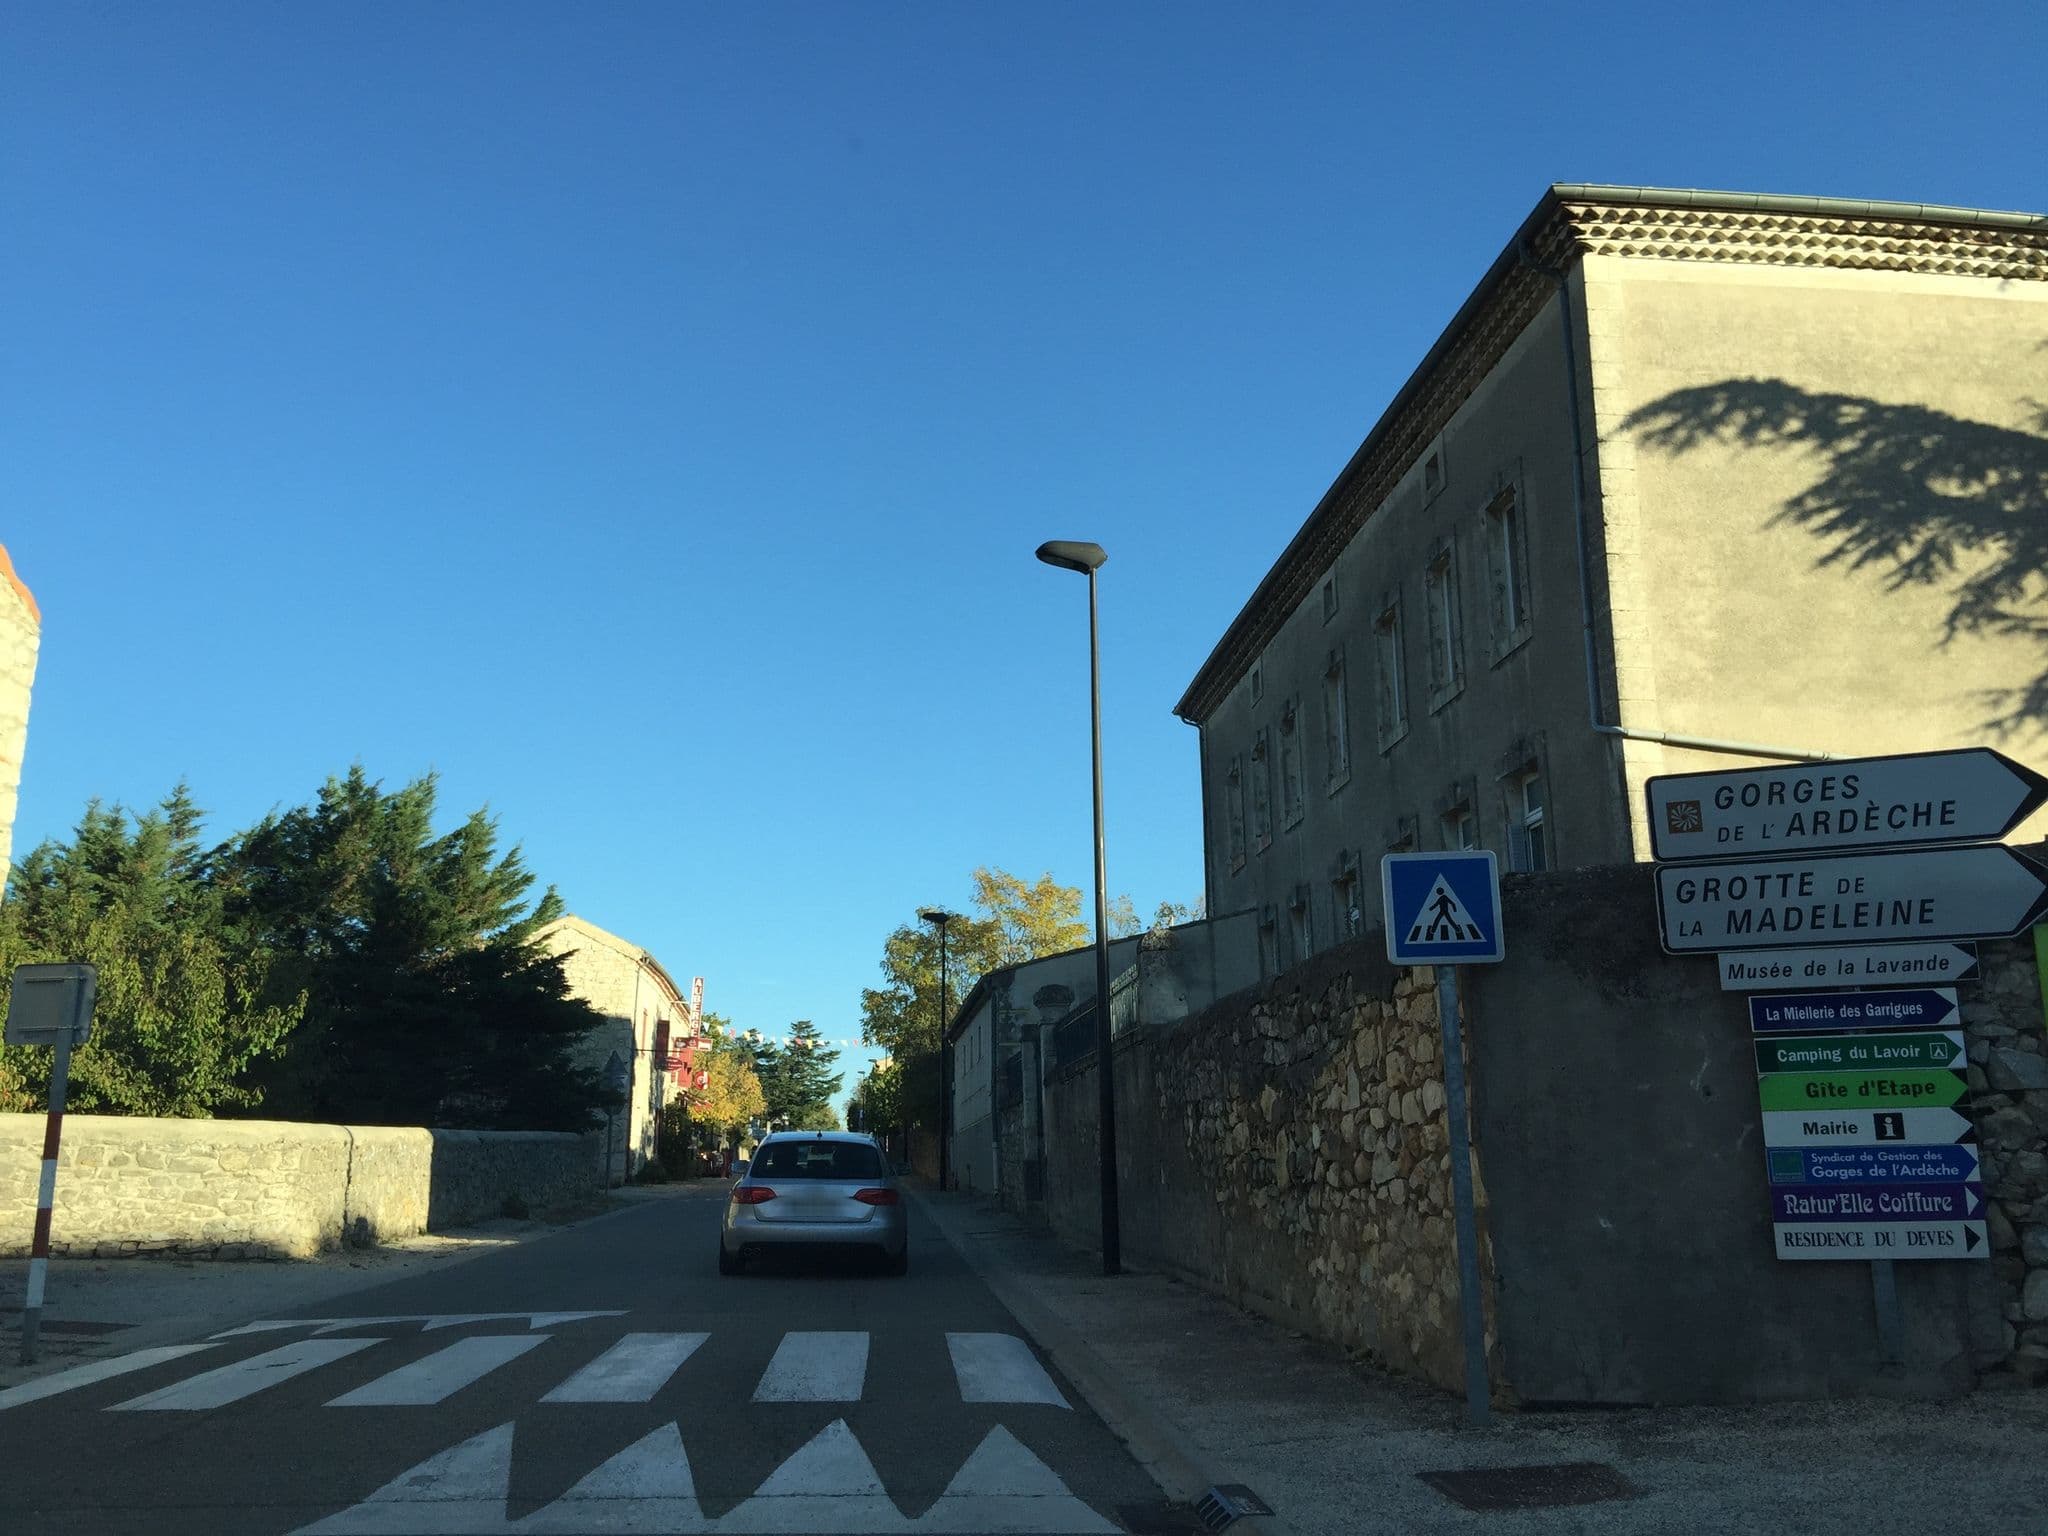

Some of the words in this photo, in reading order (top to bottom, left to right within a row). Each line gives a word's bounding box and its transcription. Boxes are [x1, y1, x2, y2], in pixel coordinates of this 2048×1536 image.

[1714, 775, 1860, 809] GORGES
[1718, 826, 1744, 843] DE
[1676, 871, 1814, 904] GROTTE
[1837, 876, 1865, 895] DE
[1679, 921, 1703, 937] LA
[1726, 898, 1935, 935] MADELEINE
[1728, 962, 1792, 980] Musée
[1804, 960, 1827, 976] de
[1838, 959, 1854, 975] la
[1865, 955, 1950, 974] Lavande
[691, 978, 703, 1037] AUBERGE
[1766, 1008, 1780, 1021] La
[1784, 1006, 1835, 1020] Miellerie
[1840, 1004, 1860, 1018] des
[1865, 1002, 1923, 1018] Garrigues
[1777, 1048, 1842, 1064] Camping
[1849, 1047, 1867, 1060] du
[1874, 1045, 1920, 1058] Lavoir
[1806, 1081, 1848, 1099] Gîte
[1858, 1079, 1936, 1098] d'Etape
[1803, 1121, 1858, 1135] Mairie
[1811, 1153, 1856, 1164] Syndicat
[1860, 1152, 1873, 1161] de
[1878, 1152, 1919, 1161] Gestion
[1923, 1150, 1943, 1160] des
[1812, 1166, 1863, 1179] Gorges
[1869, 1165, 1888, 1177] de
[1892, 1164, 1959, 1176] l'Ardèche
[1783, 1194, 1873, 1215] Natur'Elle
[1879, 1192, 1953, 1213] Coiffure
[1784, 1231, 1865, 1248] RESIDENCE
[1875, 1231, 1896, 1246] DU
[1907, 1230, 1955, 1246] DEVES
